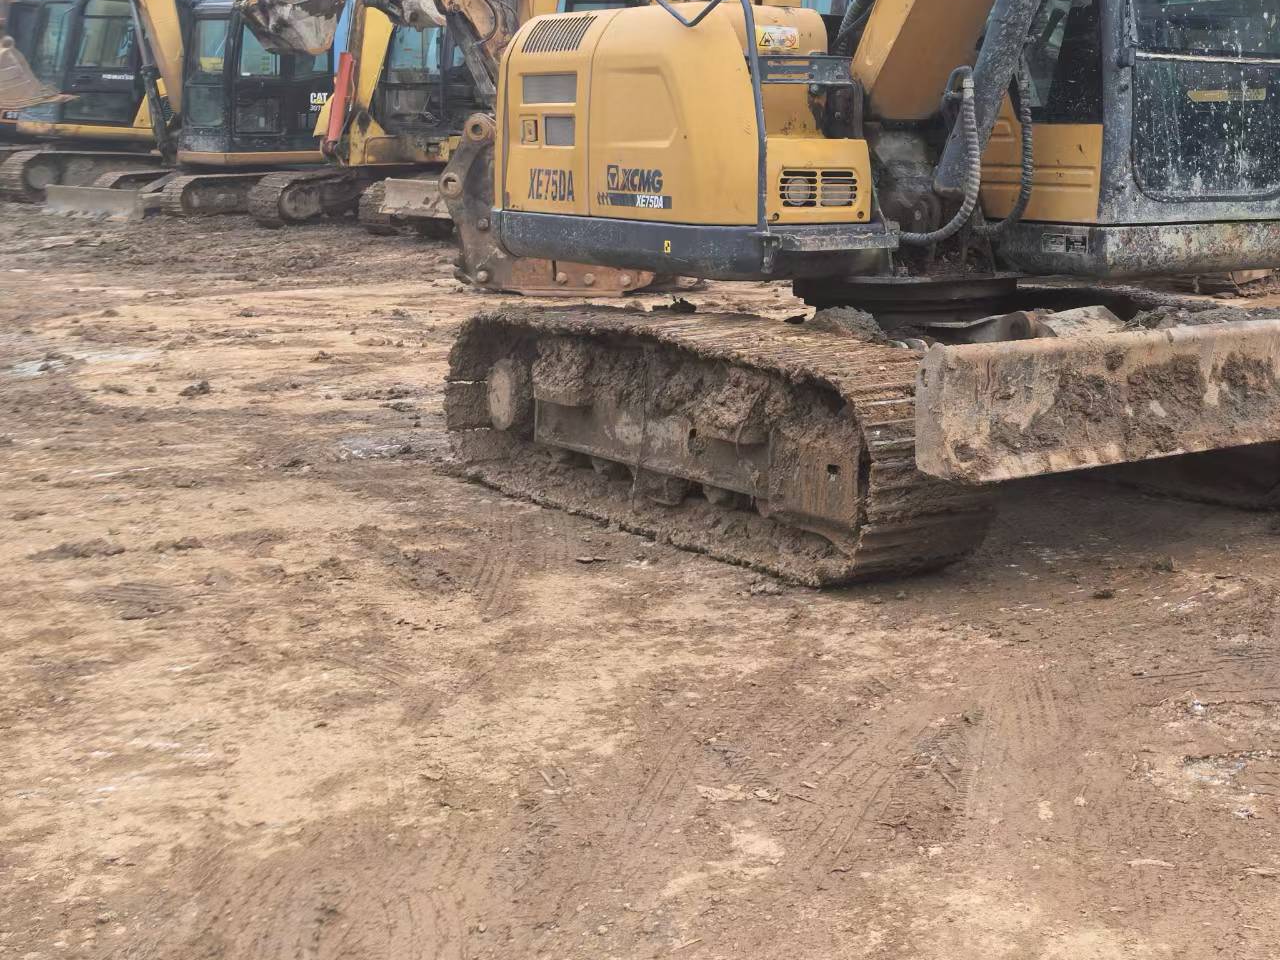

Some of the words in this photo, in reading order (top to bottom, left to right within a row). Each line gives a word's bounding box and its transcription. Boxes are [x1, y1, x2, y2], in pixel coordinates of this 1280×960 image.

[310, 93, 328, 104] CAT
[528, 168, 575, 202] XE75DA
[620, 169, 663, 193] XCMG
[636, 195, 663, 208] XE75DA
